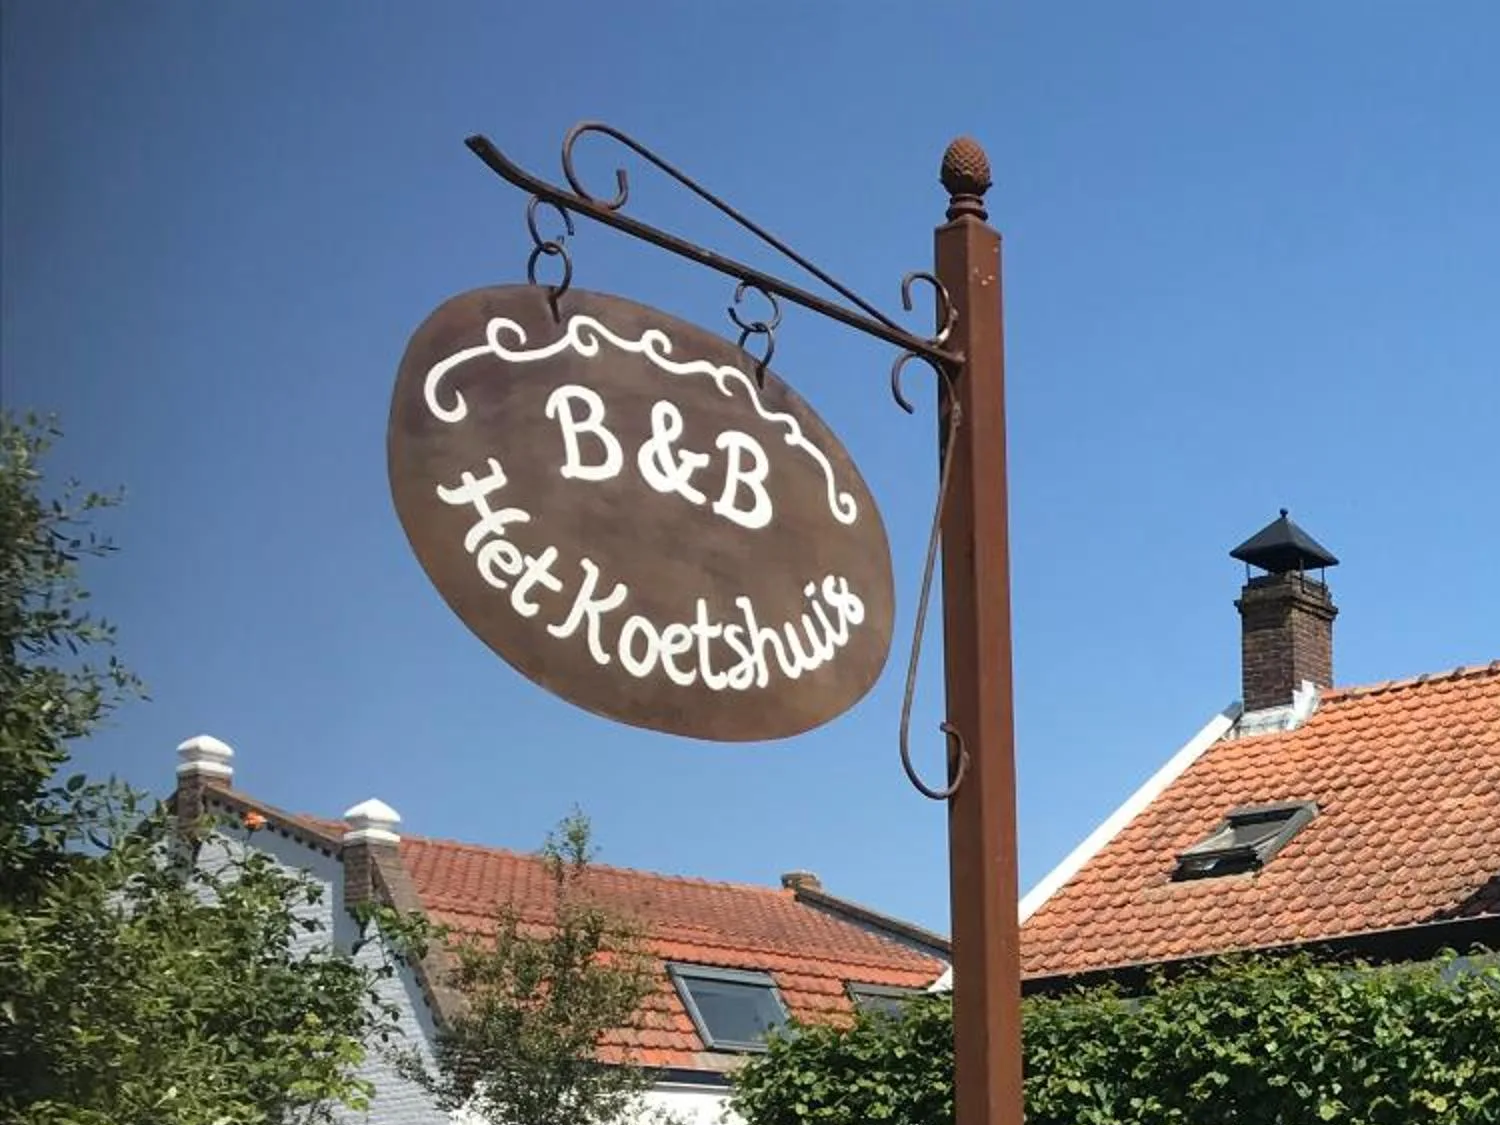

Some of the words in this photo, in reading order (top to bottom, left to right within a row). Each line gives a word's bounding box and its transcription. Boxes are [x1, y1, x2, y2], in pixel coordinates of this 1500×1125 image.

[545, 384, 774, 530] B&B
[437, 457, 563, 617] Het
[547, 558, 865, 691] Koetshuis
